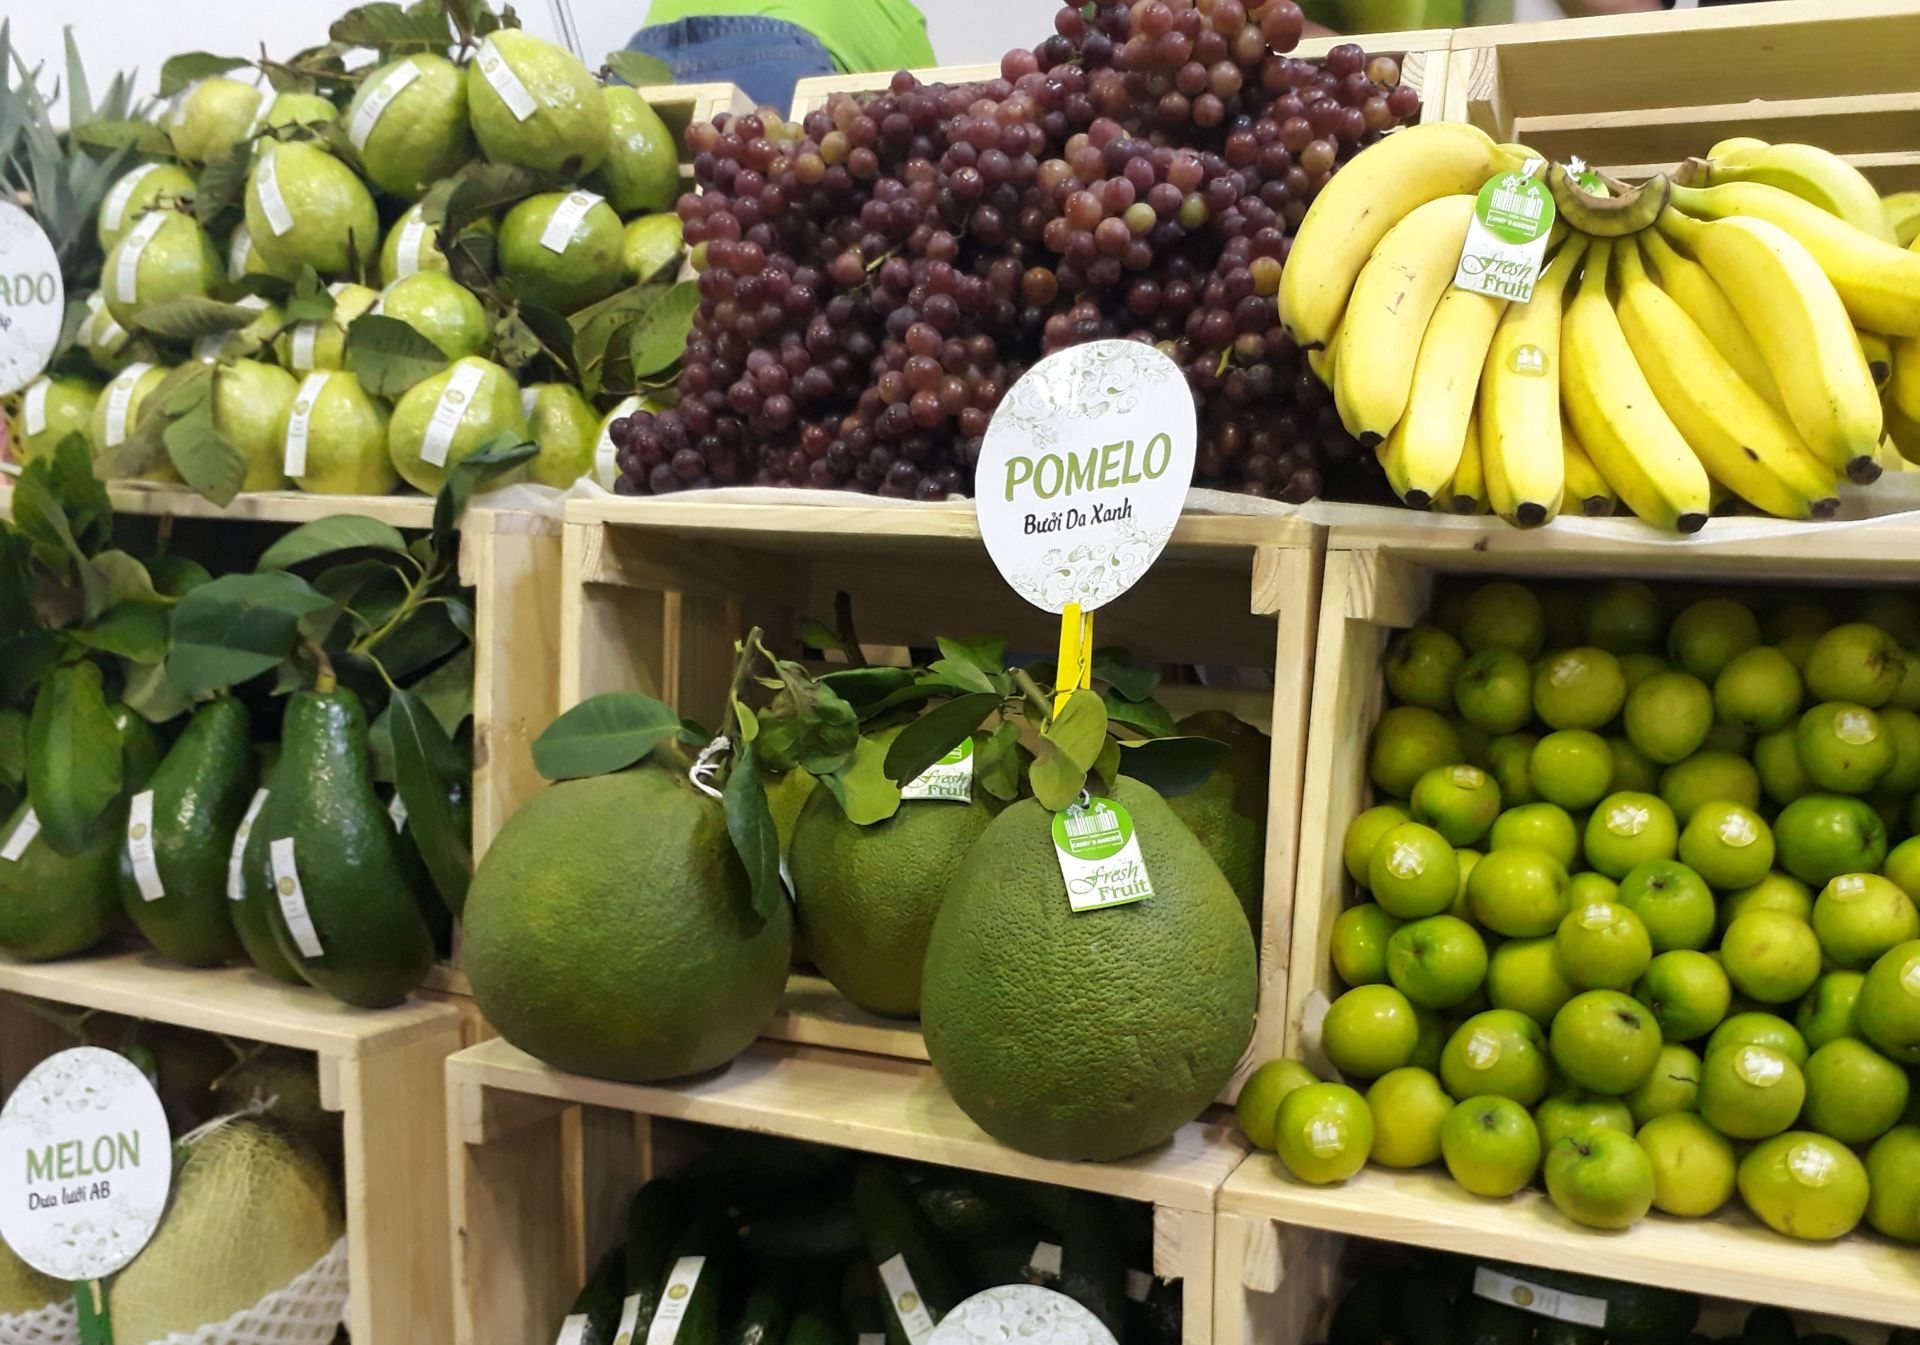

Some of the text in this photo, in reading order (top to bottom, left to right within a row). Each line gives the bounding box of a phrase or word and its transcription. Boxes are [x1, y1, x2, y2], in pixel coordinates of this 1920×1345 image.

[1461, 252, 1533, 283] Fresh
[1481, 273, 1530, 299] Fruit
[1004, 432, 1172, 502] POMELO
[1023, 497, 1132, 535] Bưởi Da Xanh
[1068, 860, 1138, 894] Fresh
[1097, 879, 1149, 901] Fruit
[26, 1129, 140, 1185] MELON
[90, 1180, 111, 1201] AB
